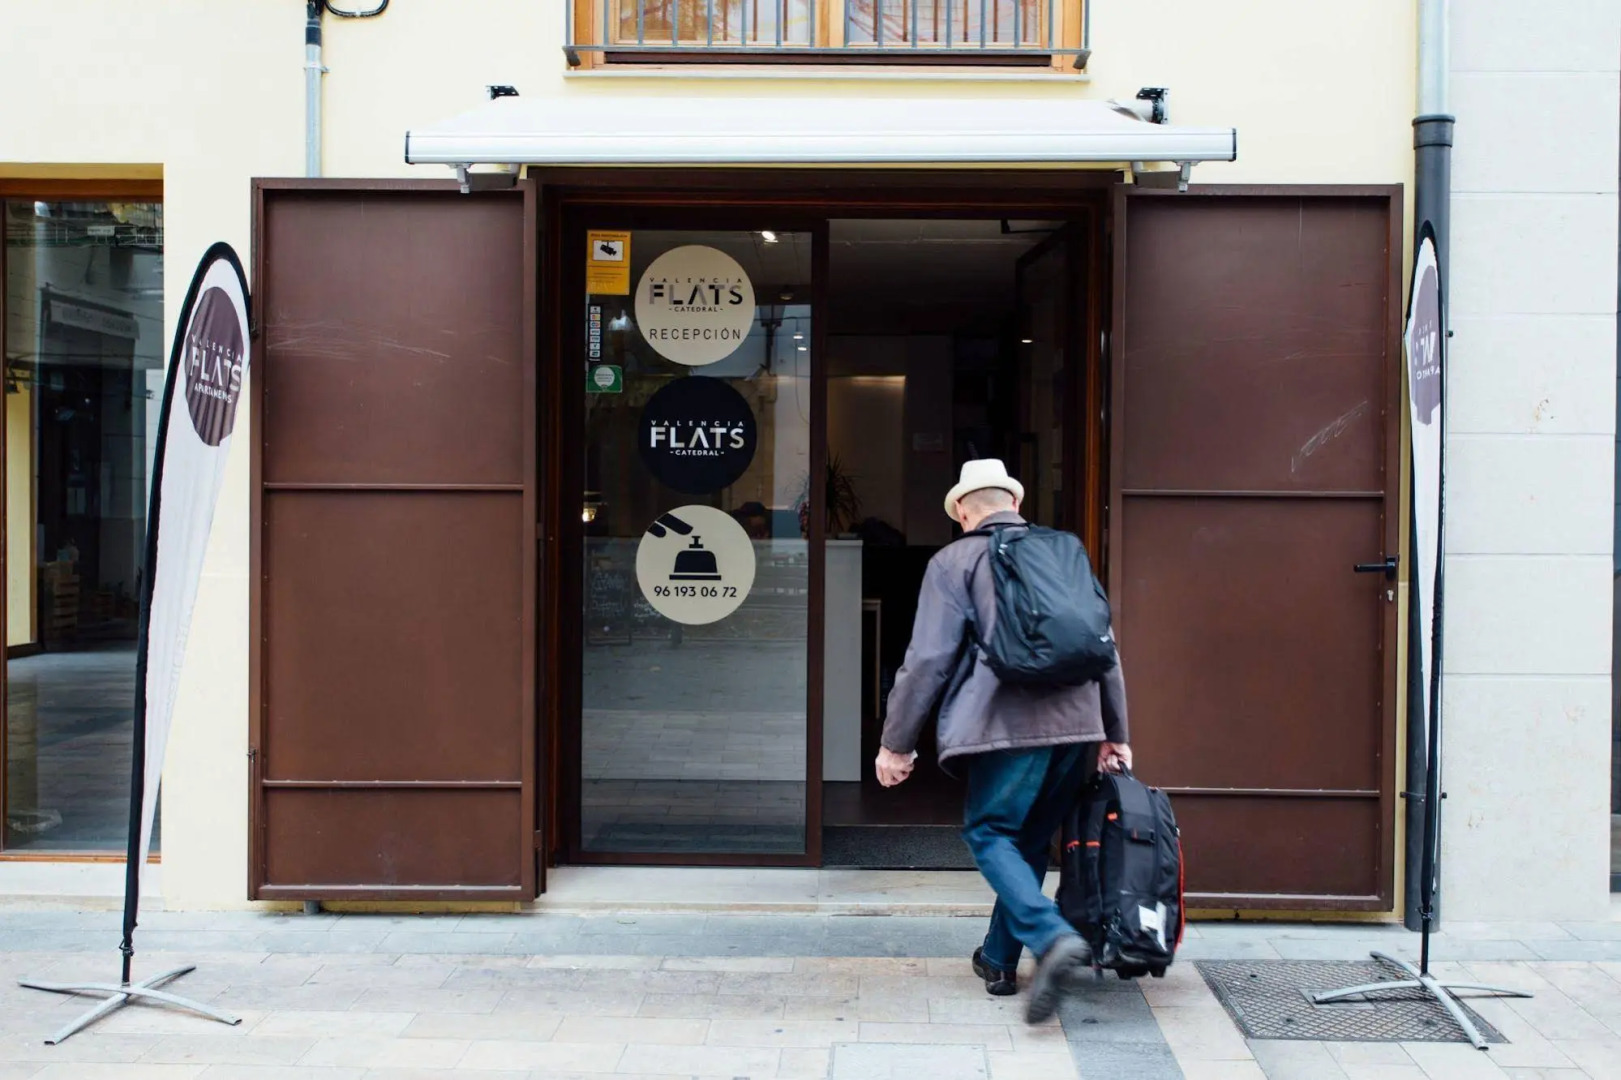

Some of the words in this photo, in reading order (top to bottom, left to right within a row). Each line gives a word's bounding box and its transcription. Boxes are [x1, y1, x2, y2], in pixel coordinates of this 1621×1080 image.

[649, 284, 743, 305] FLATS
[649, 327, 741, 340] RECEPCIÓN
[190, 346, 242, 392] FLATS
[650, 427, 745, 448] FLATS
[654, 586, 671, 597] 96
[674, 586, 696, 597] 193
[700, 586, 718, 597] 06
[722, 586, 737, 597] 72
